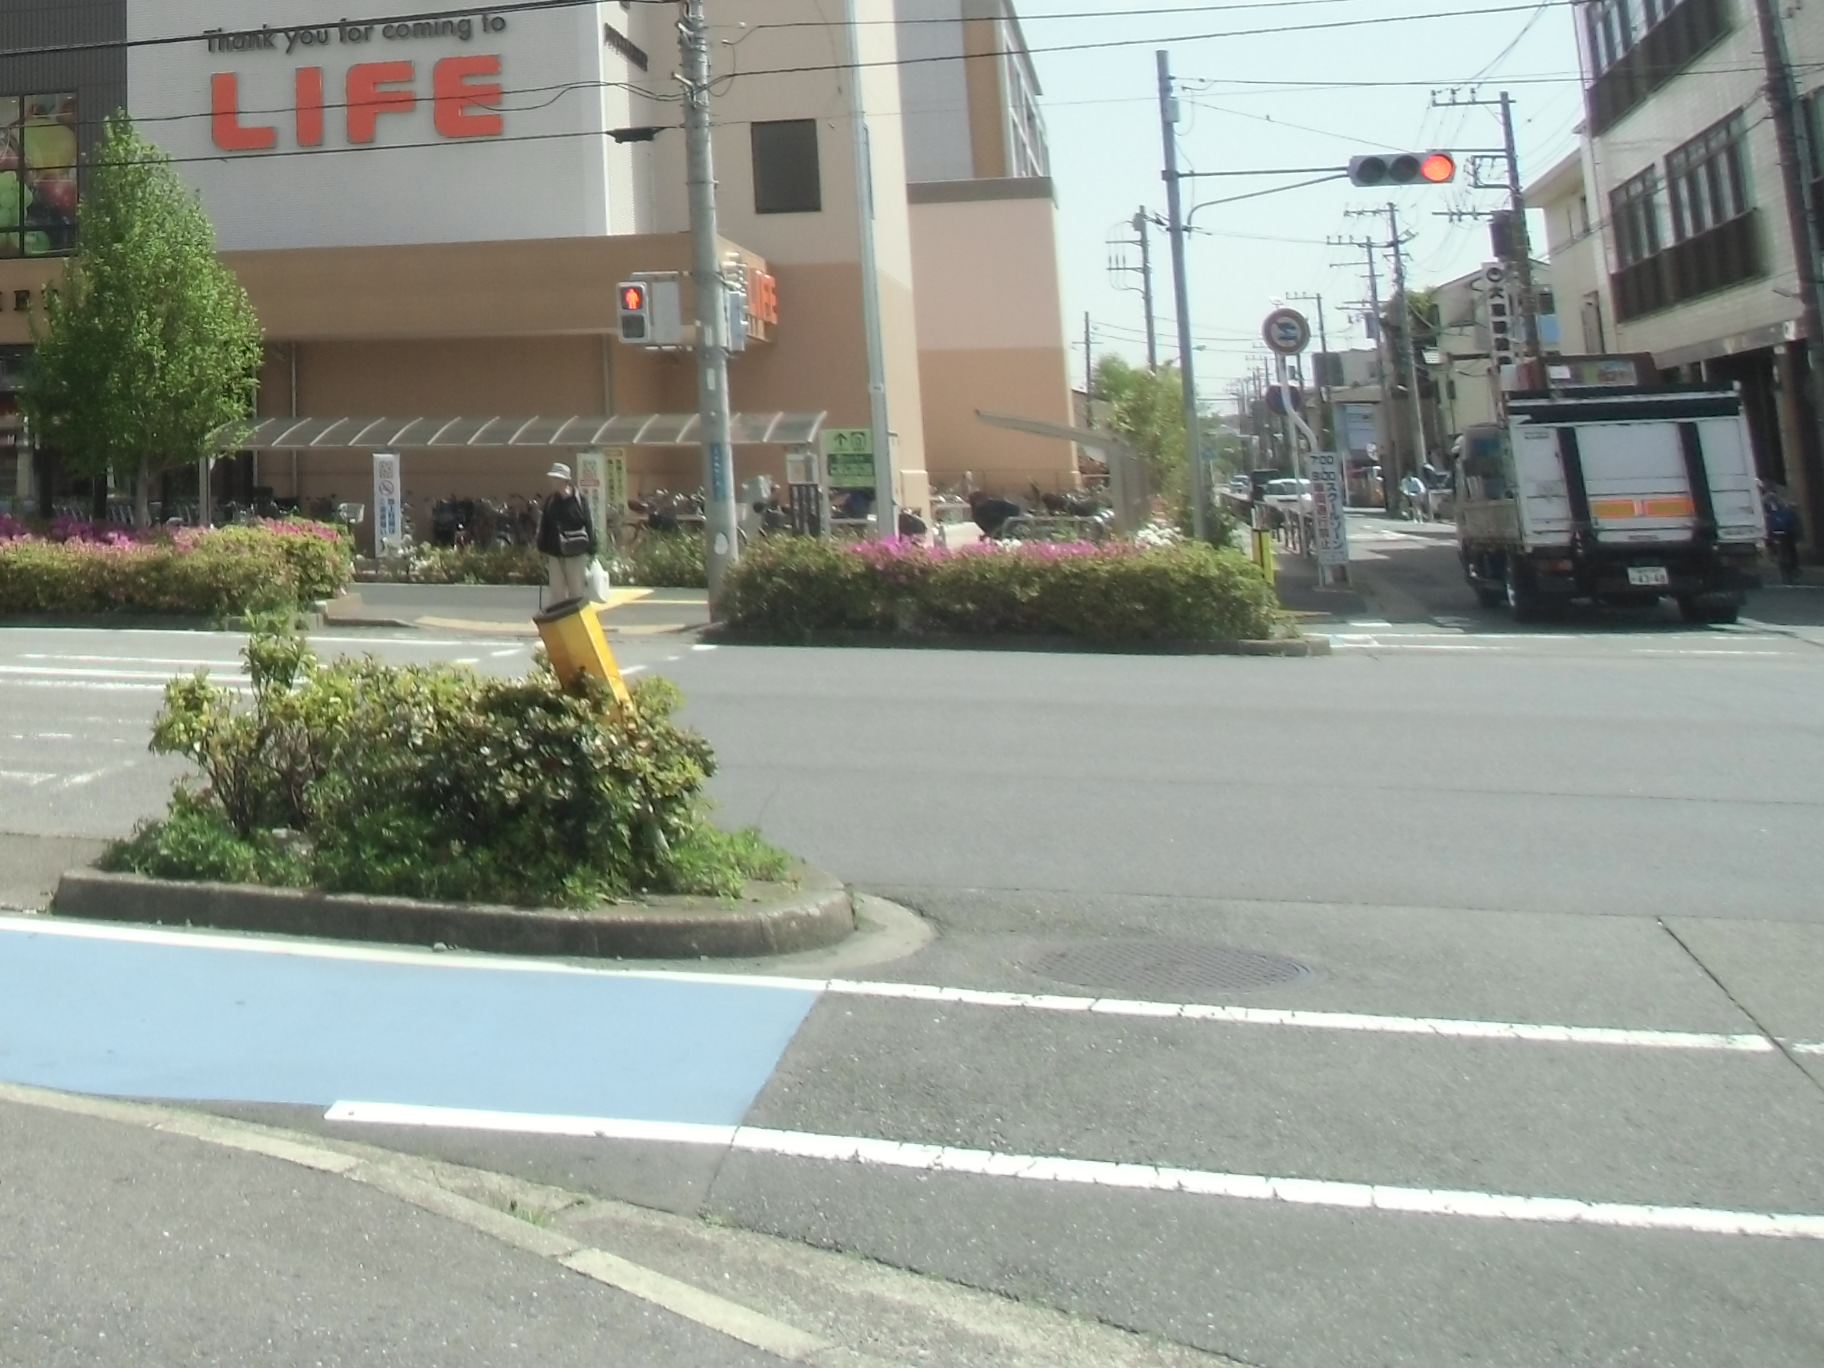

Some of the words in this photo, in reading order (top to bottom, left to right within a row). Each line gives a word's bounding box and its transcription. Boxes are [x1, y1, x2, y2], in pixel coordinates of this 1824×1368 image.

[204, 24, 277, 53] Thank
[283, 26, 328, 55] you
[337, 17, 374, 43] for
[381, 16, 474, 41] coming
[482, 12, 507, 33] to
[211, 53, 504, 152] LIFE
